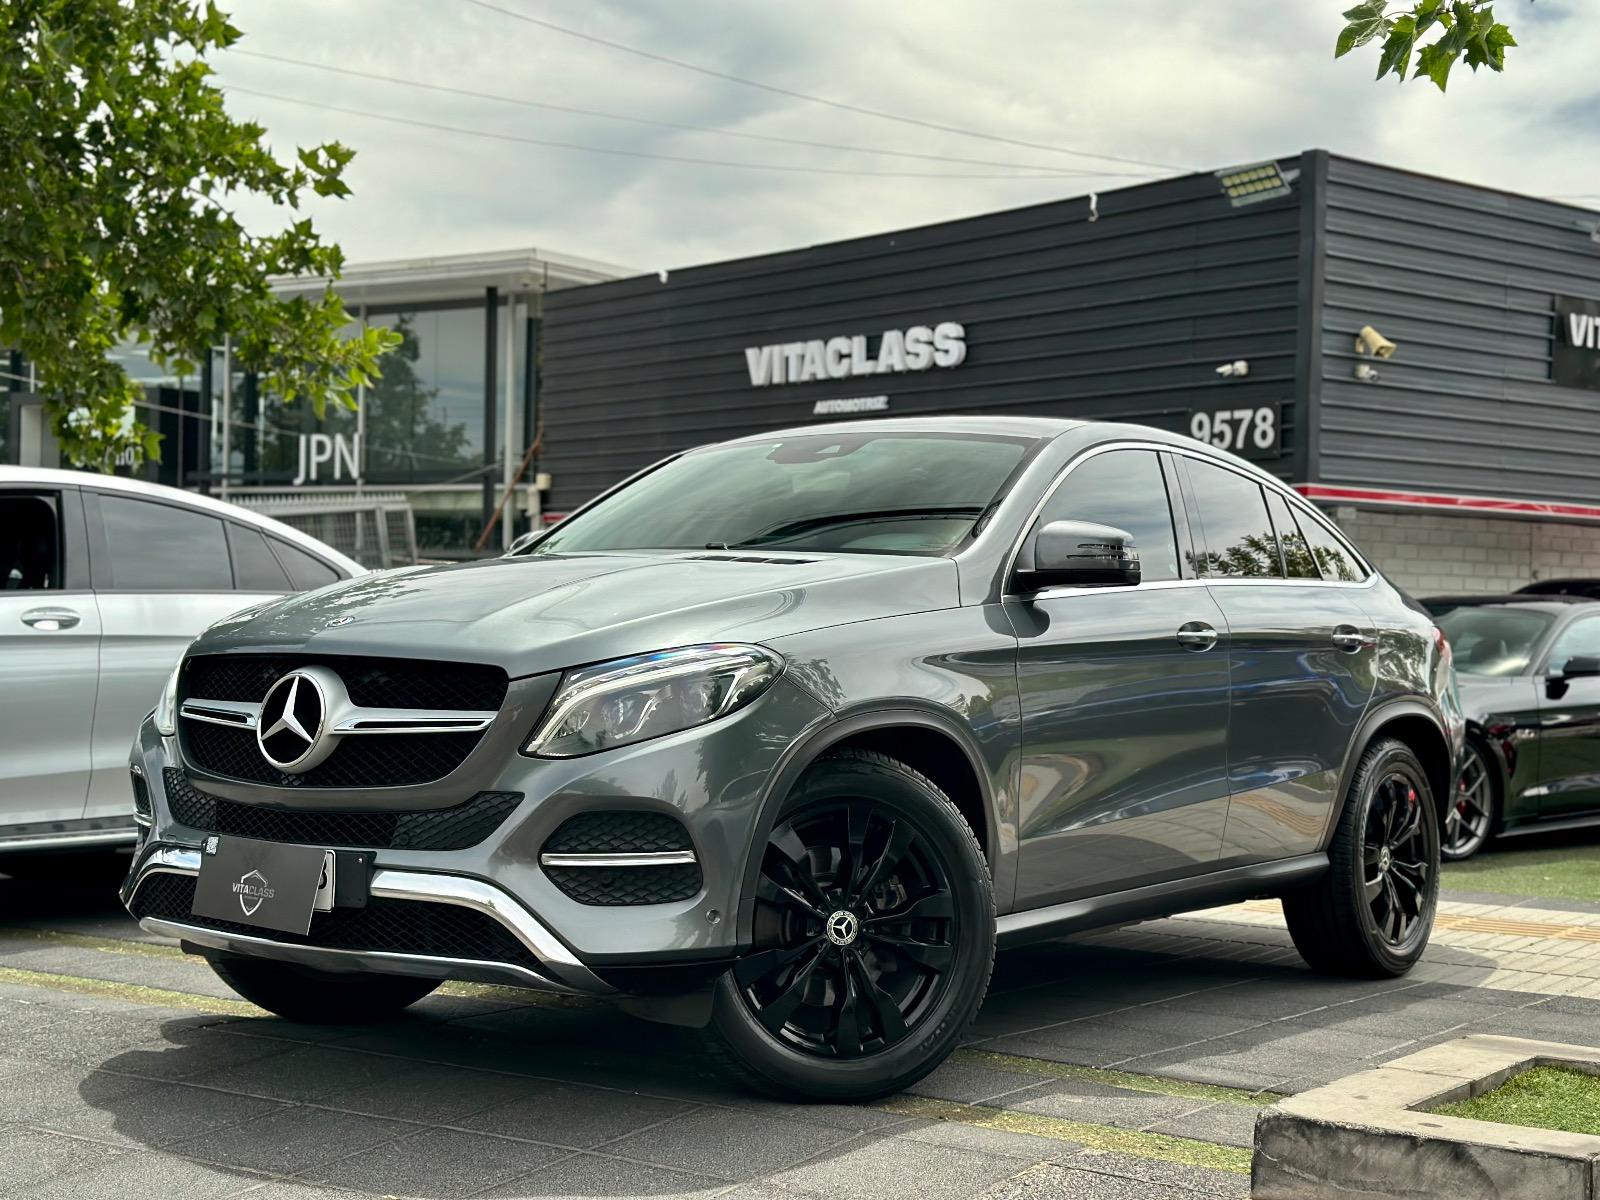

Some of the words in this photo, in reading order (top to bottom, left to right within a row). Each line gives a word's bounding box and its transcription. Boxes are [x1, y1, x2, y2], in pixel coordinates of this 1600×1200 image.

[745, 322, 967, 386] VITACLASS
[1190, 407, 1275, 450] 9578
[292, 432, 360, 486] JPN
[232, 882, 275, 898] VITACLASS
